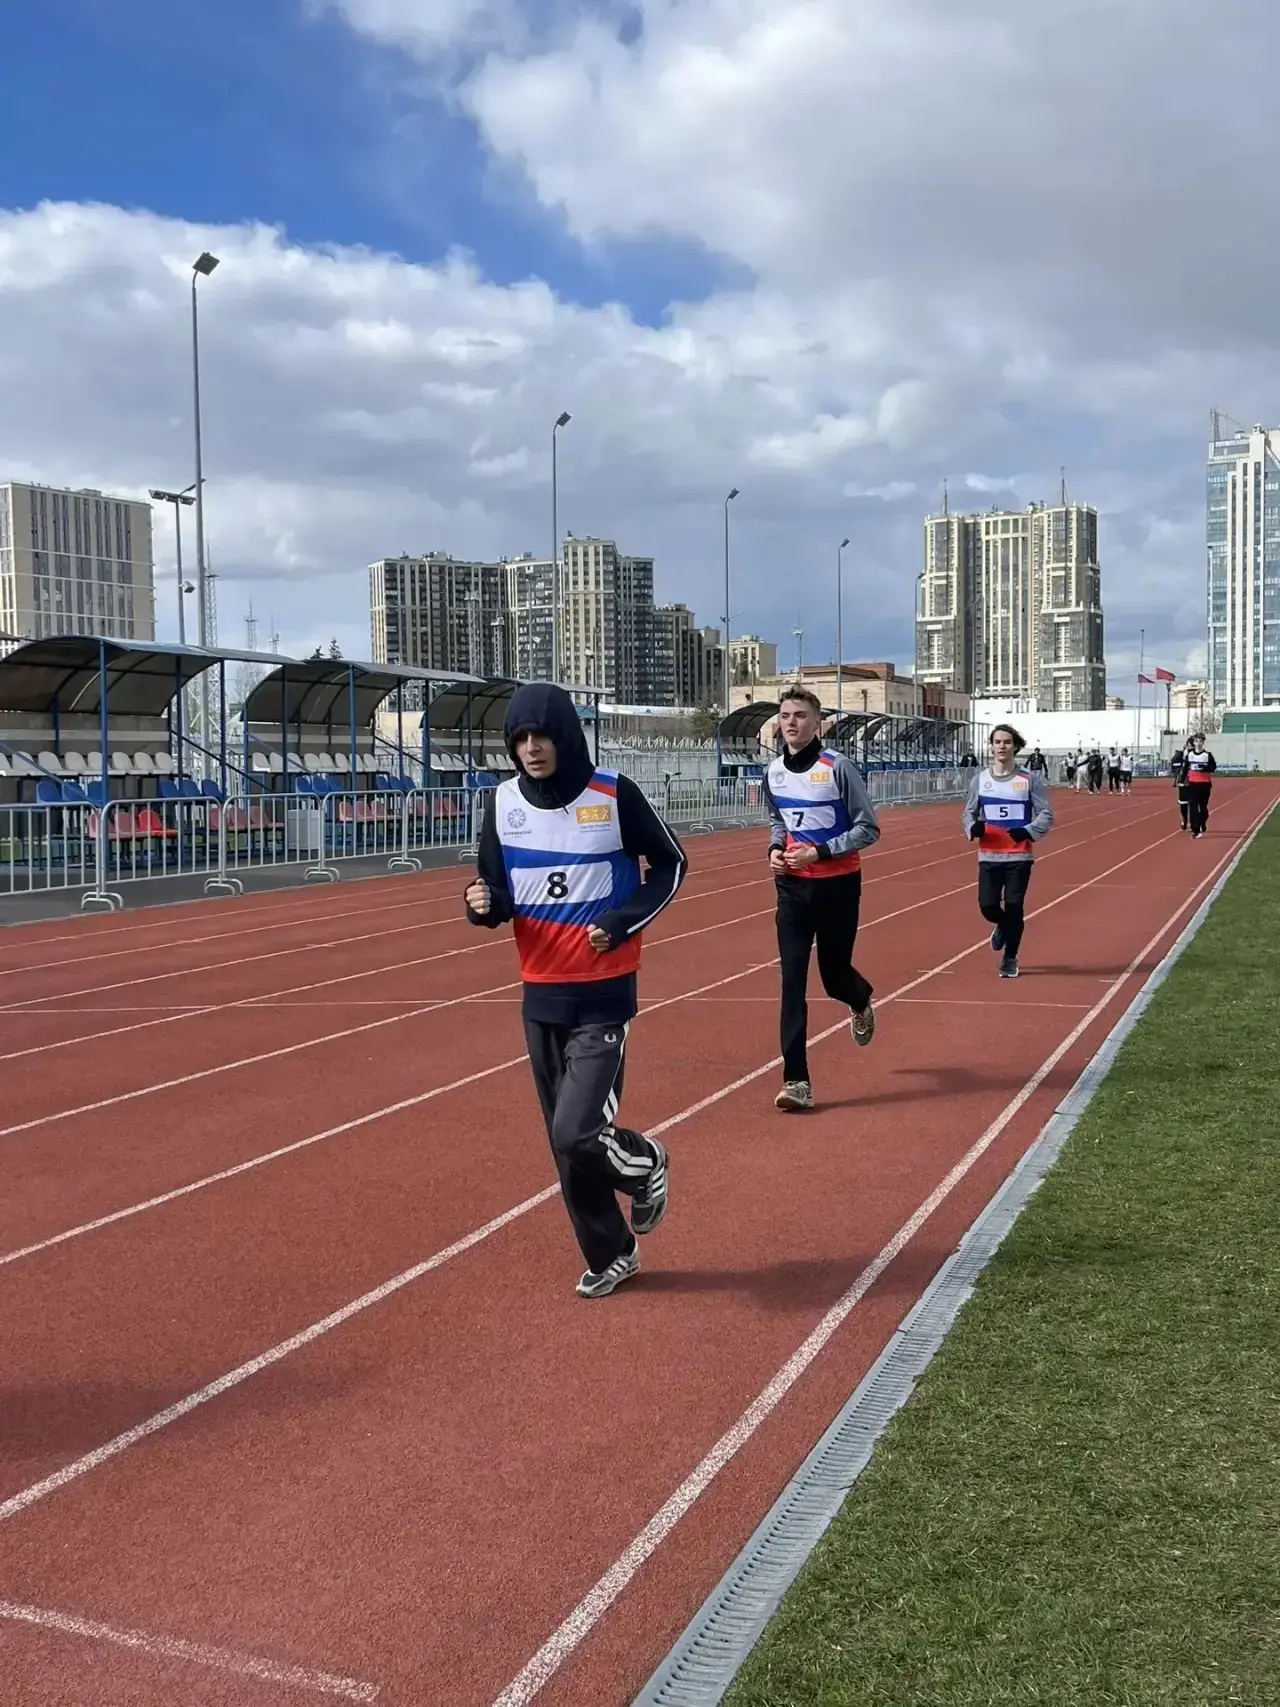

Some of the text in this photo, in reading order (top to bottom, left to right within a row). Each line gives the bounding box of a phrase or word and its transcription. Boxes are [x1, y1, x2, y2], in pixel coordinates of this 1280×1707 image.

[792, 811, 805, 828] 7
[999, 806, 1009, 818] 5
[547, 871, 569, 899] 8
